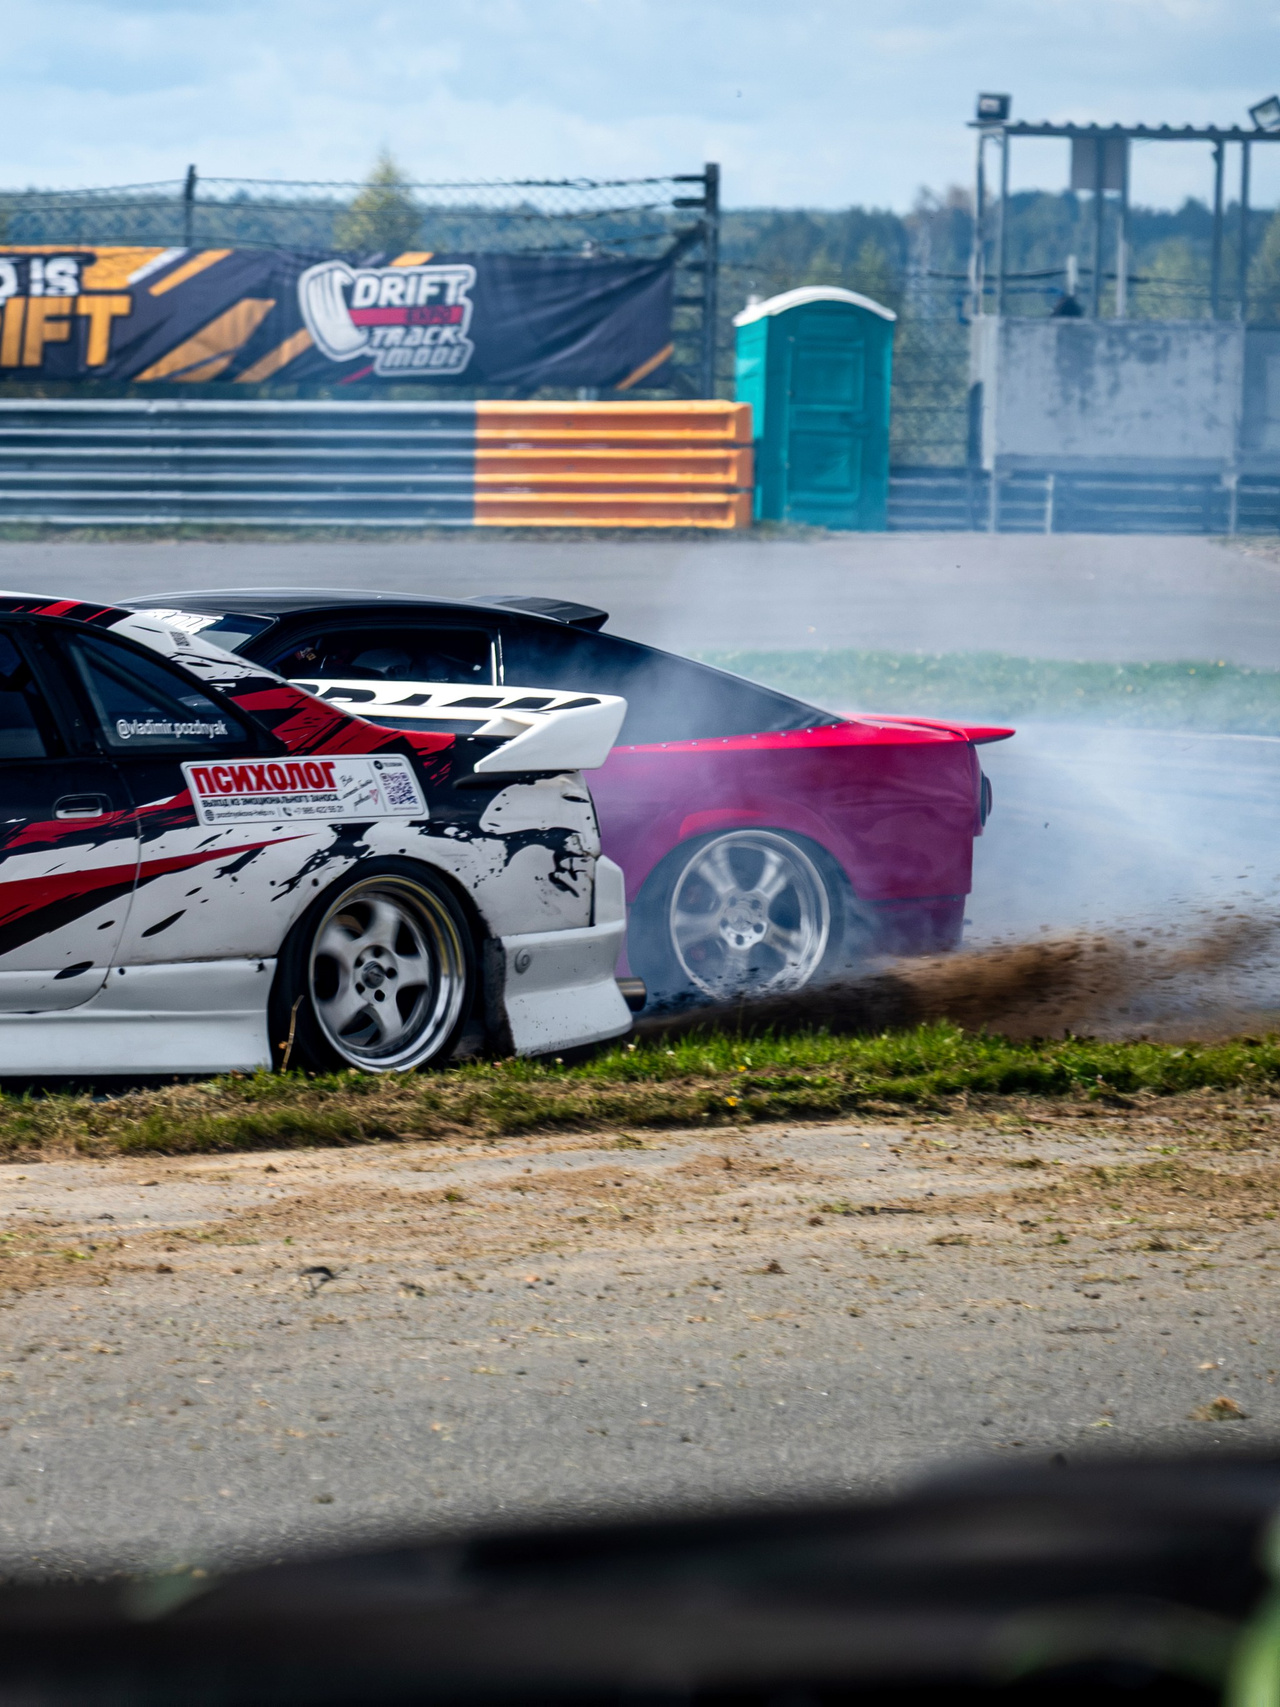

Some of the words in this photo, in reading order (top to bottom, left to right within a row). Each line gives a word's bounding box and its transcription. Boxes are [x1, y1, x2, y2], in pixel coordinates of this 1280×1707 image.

[29, 256, 80, 297] IS
[351, 273, 468, 309] DRIFT
[191, 761, 337, 794] ПСИХОЛОГ
